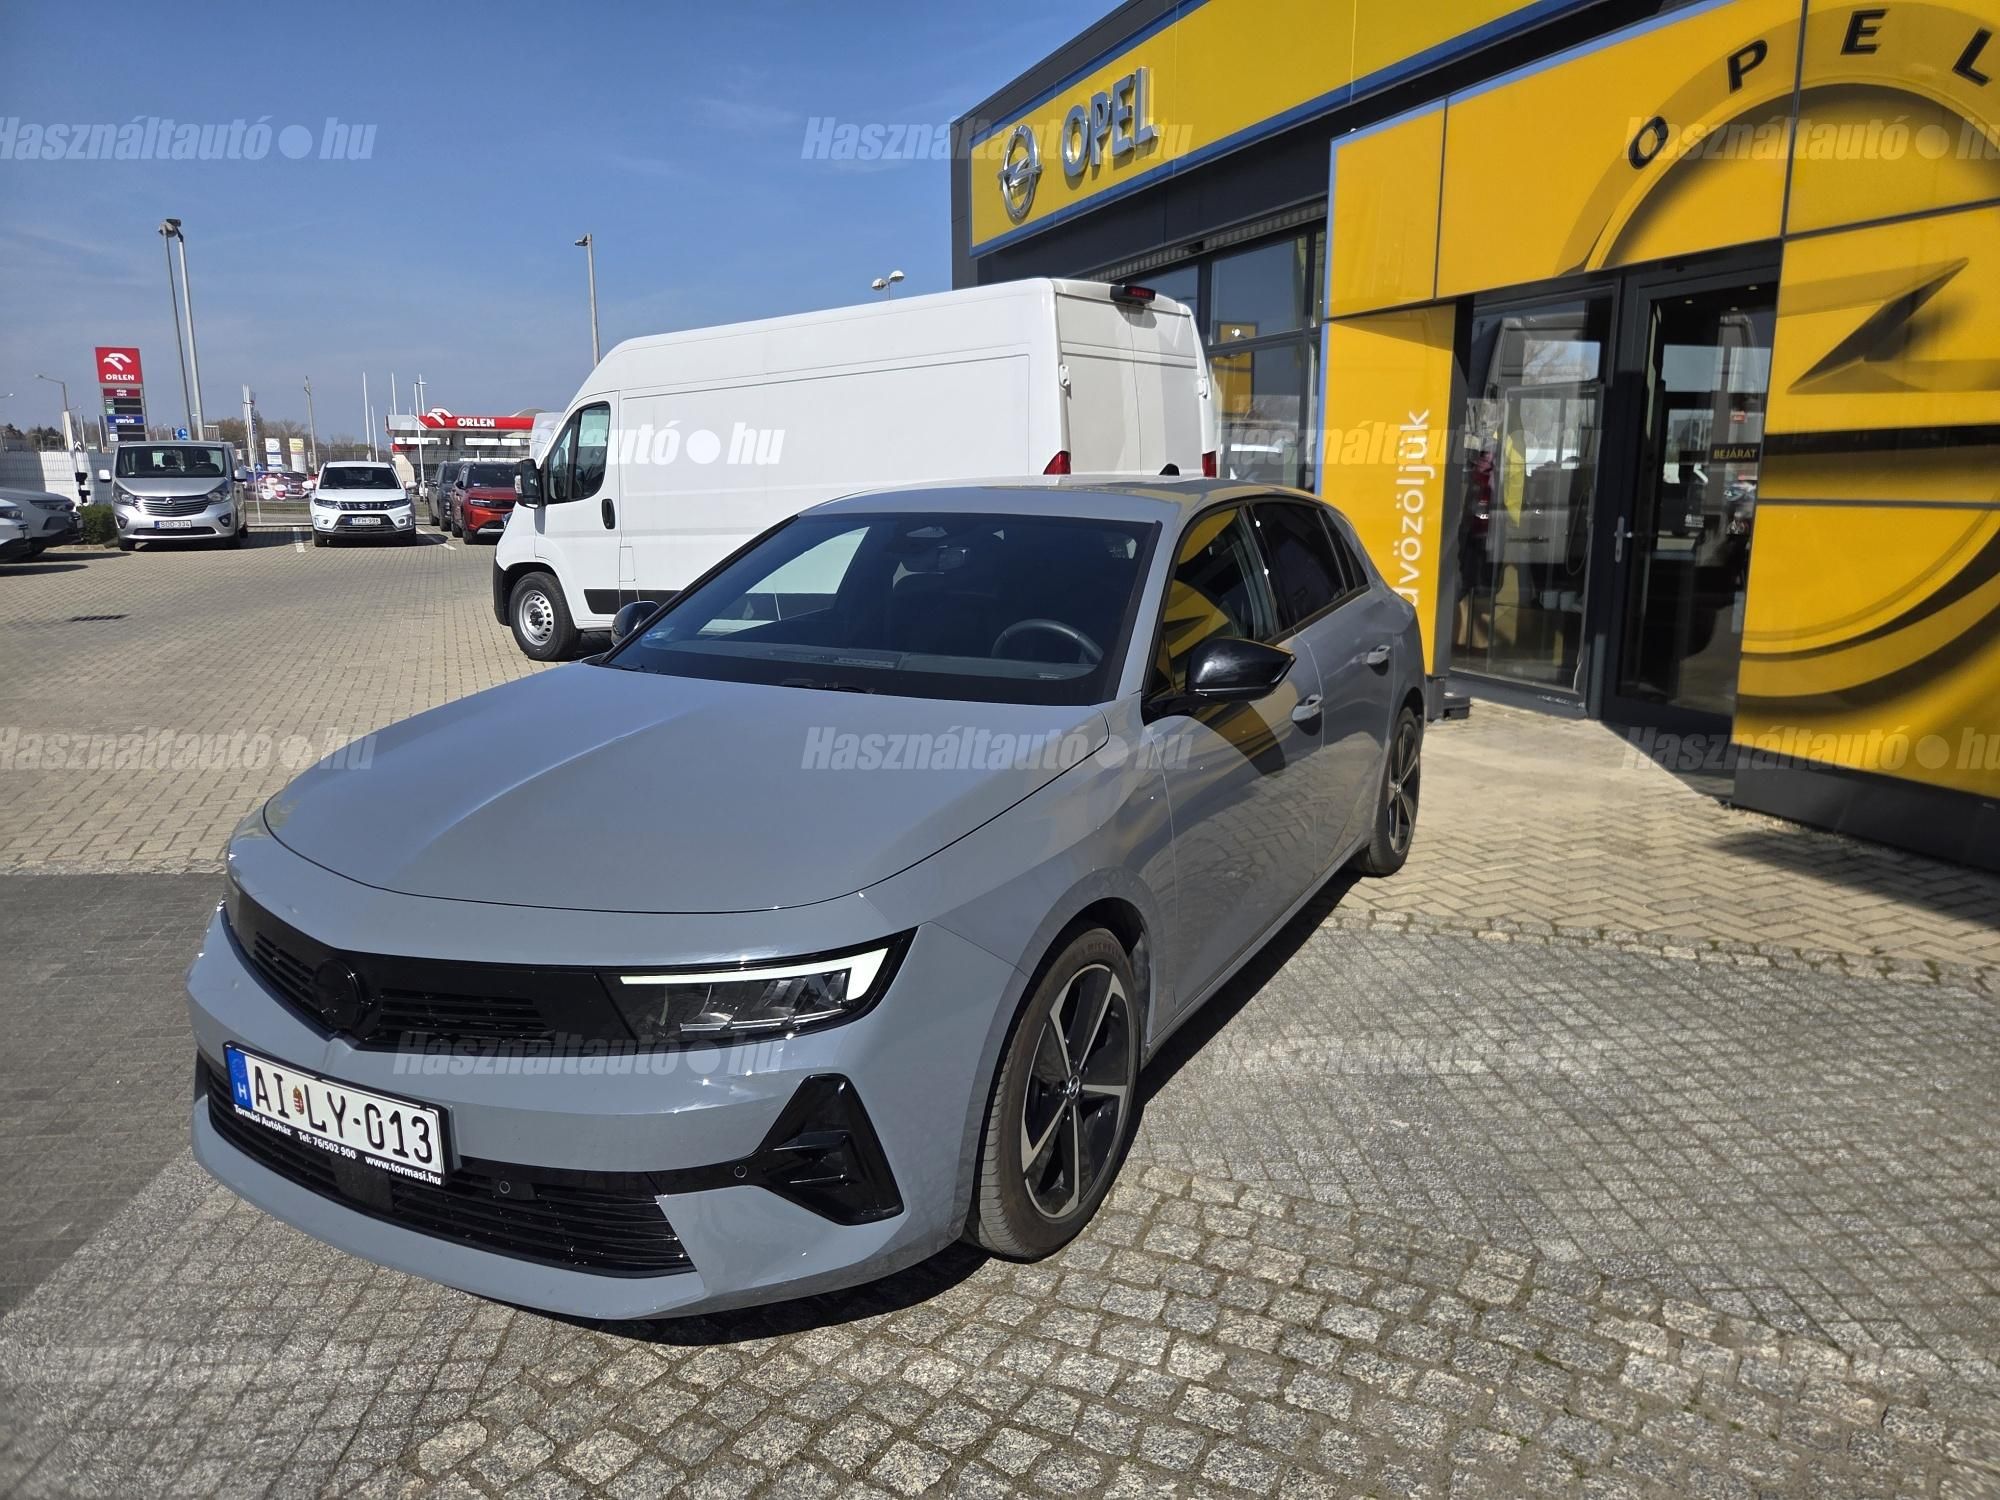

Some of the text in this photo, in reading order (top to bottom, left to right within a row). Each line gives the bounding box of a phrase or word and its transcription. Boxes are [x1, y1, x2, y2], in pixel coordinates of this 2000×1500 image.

[1062, 66, 1158, 176] OPEL
[1627, 8, 1992, 170] OPEL
[105, 373, 135, 381] ORLEN
[456, 417, 496, 427] ORLEN
[1713, 448, 1758, 460] BEJÁRAT
[1392, 409, 1435, 607] dvözöljük
[237, 1082, 248, 1100] H
[255, 1066, 433, 1164] AI LY-013
[261, 1116, 292, 1136] Autóház
[298, 1131, 312, 1144] Tel:
[313, 1136, 339, 1154] 76/502
[341, 1147, 357, 1160] 900
[365, 1156, 442, 1185] www.tormasi.hu
